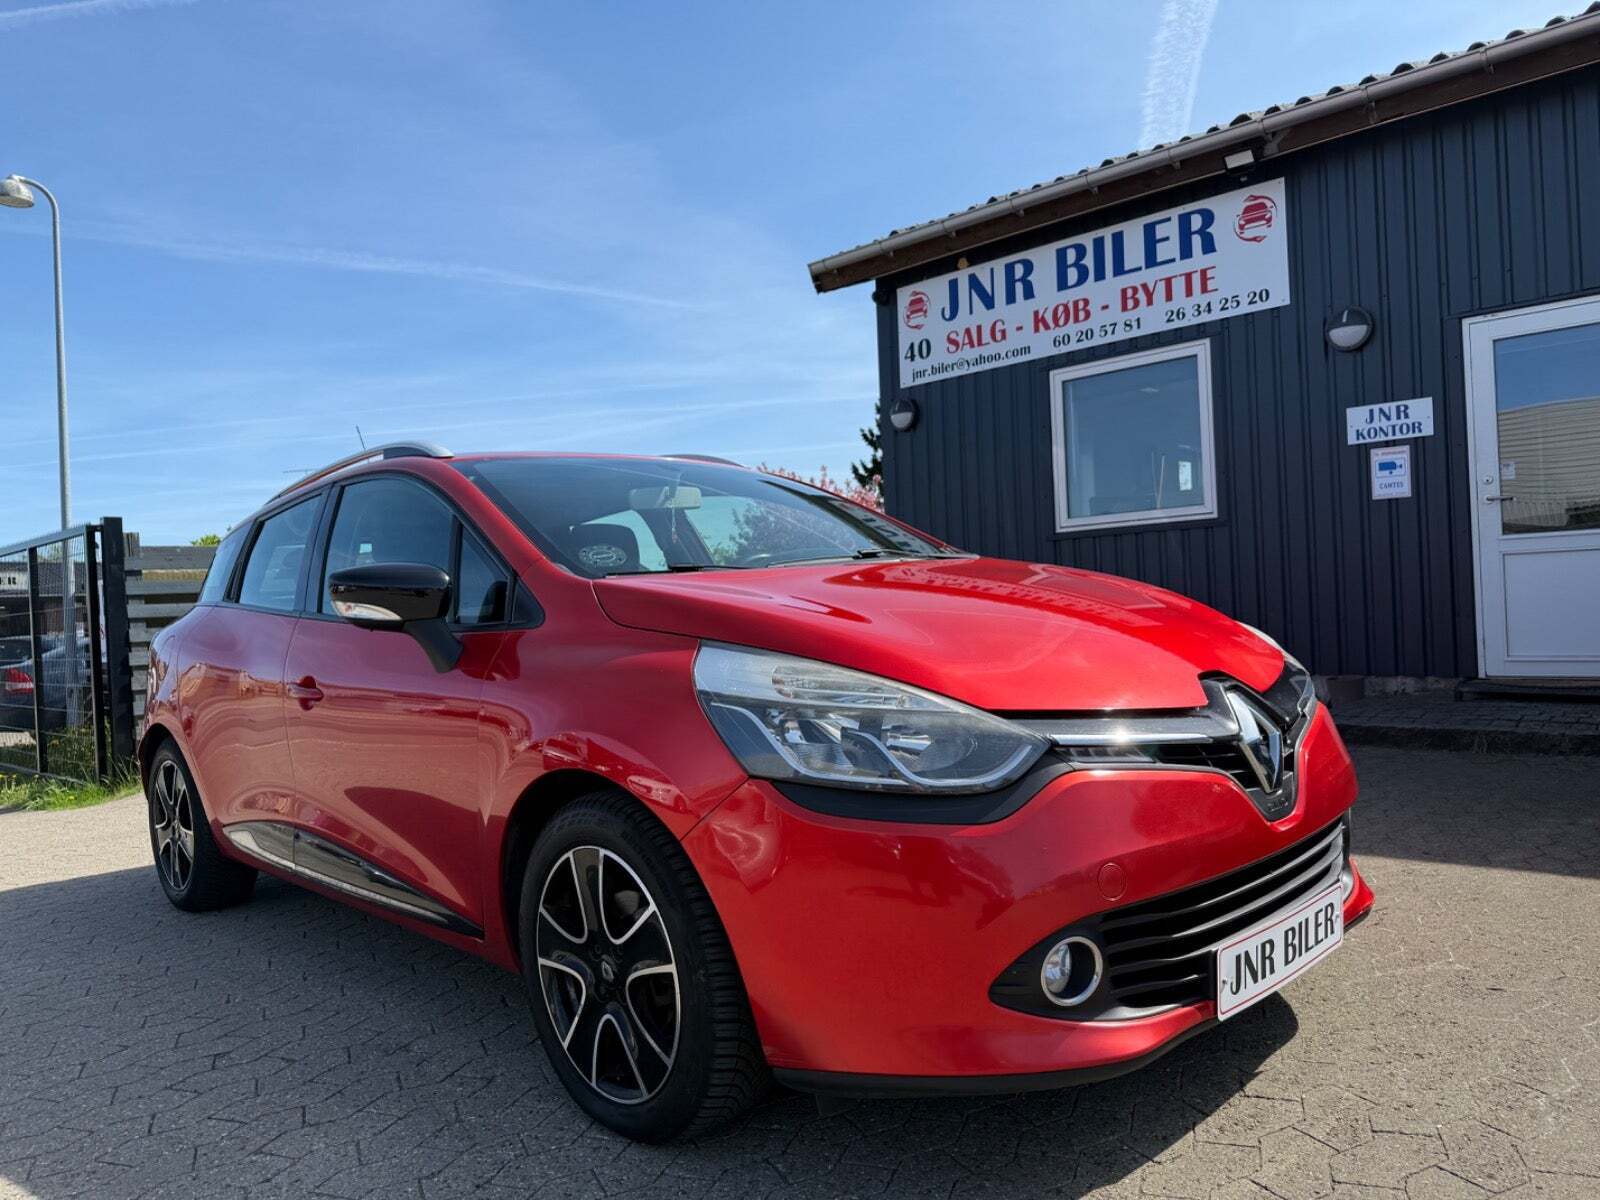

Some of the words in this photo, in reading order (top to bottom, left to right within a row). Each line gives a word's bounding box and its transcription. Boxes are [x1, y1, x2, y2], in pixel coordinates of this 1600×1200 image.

[941, 257, 1035, 322] JNR
[1055, 207, 1217, 293] BILER
[946, 318, 1008, 354] SALG
[1033, 297, 1092, 334] KØB
[1120, 265, 1218, 313] BYTTE
[1053, 333, 1071, 349] 60
[1075, 327, 1095, 344] 20
[1099, 322, 1118, 338] 57
[1123, 317, 1142, 333] 81
[1165, 306, 1187, 324] 26
[1191, 300, 1213, 318] 34
[1219, 294, 1241, 312] 25
[1247, 288, 1270, 306] 20
[904, 338, 932, 362] 40
[912, 345, 1032, 382] jnr.biler@yahoo.com
[1356, 420, 1423, 441] KONTOR
[1365, 404, 1410, 425] JNR
[1230, 938, 1275, 995] JNR
[1284, 902, 1335, 967] BILER
